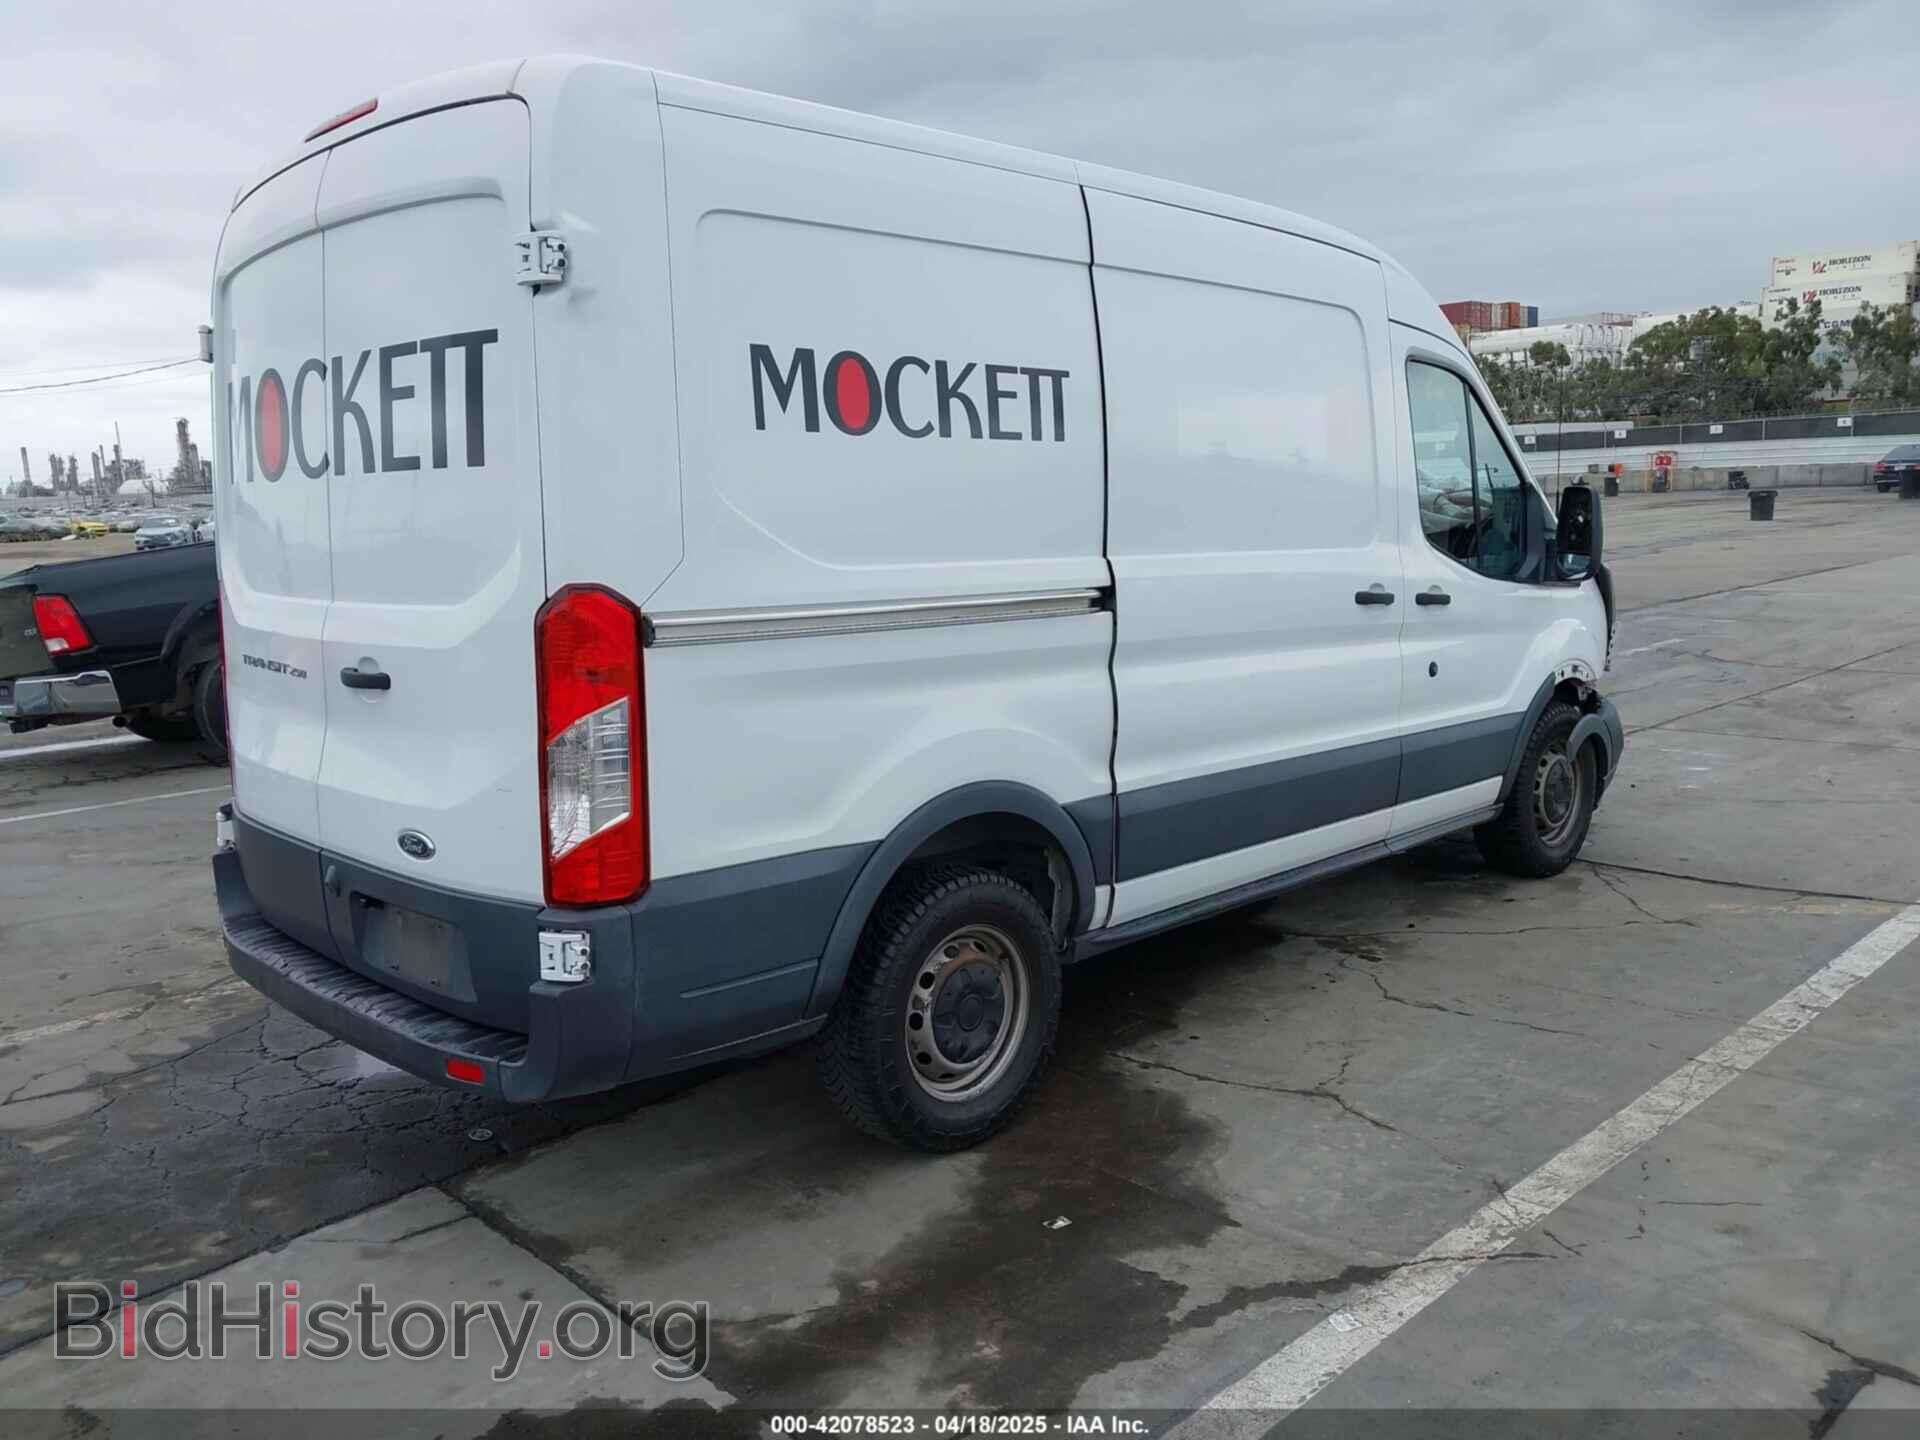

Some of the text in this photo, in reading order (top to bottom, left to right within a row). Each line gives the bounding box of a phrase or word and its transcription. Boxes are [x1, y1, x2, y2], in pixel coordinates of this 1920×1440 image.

[1829, 255, 1871, 265] HORIZON
[1819, 286, 1861, 296] HORIZON
[749, 343, 1070, 442] MOCKETT
[228, 328, 498, 484] MOCKETT
[242, 654, 290, 674] TRANSIT
